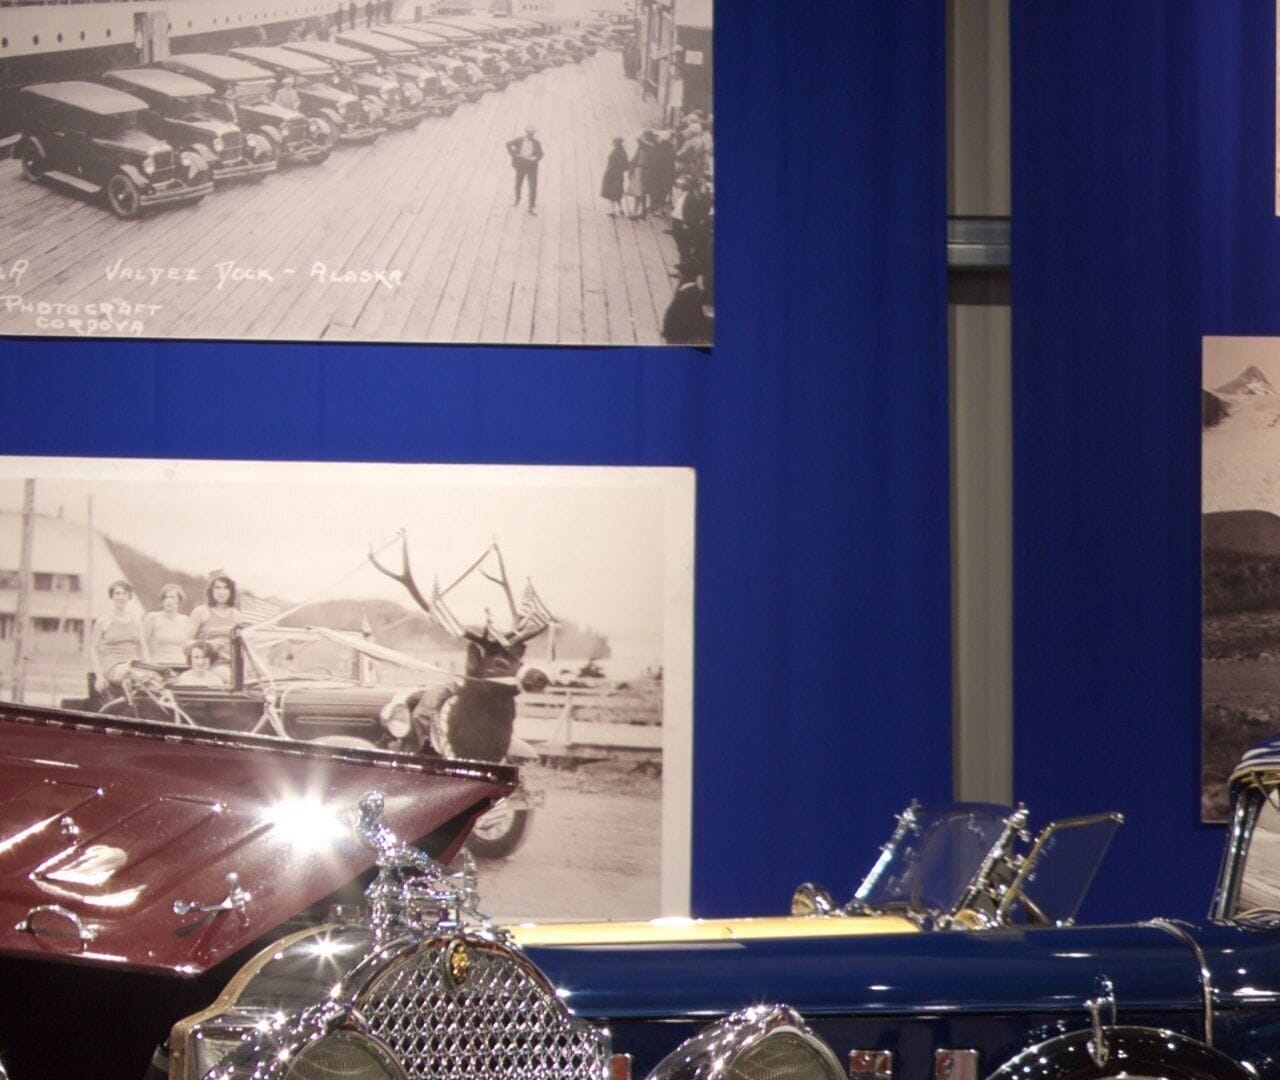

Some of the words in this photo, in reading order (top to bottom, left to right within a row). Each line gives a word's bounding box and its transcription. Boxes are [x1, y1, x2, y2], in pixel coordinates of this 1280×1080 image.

[214, 260, 274, 289] DOCK
[310, 261, 404, 288] ALASKA
[35, 315, 145, 336] CORDOVA
